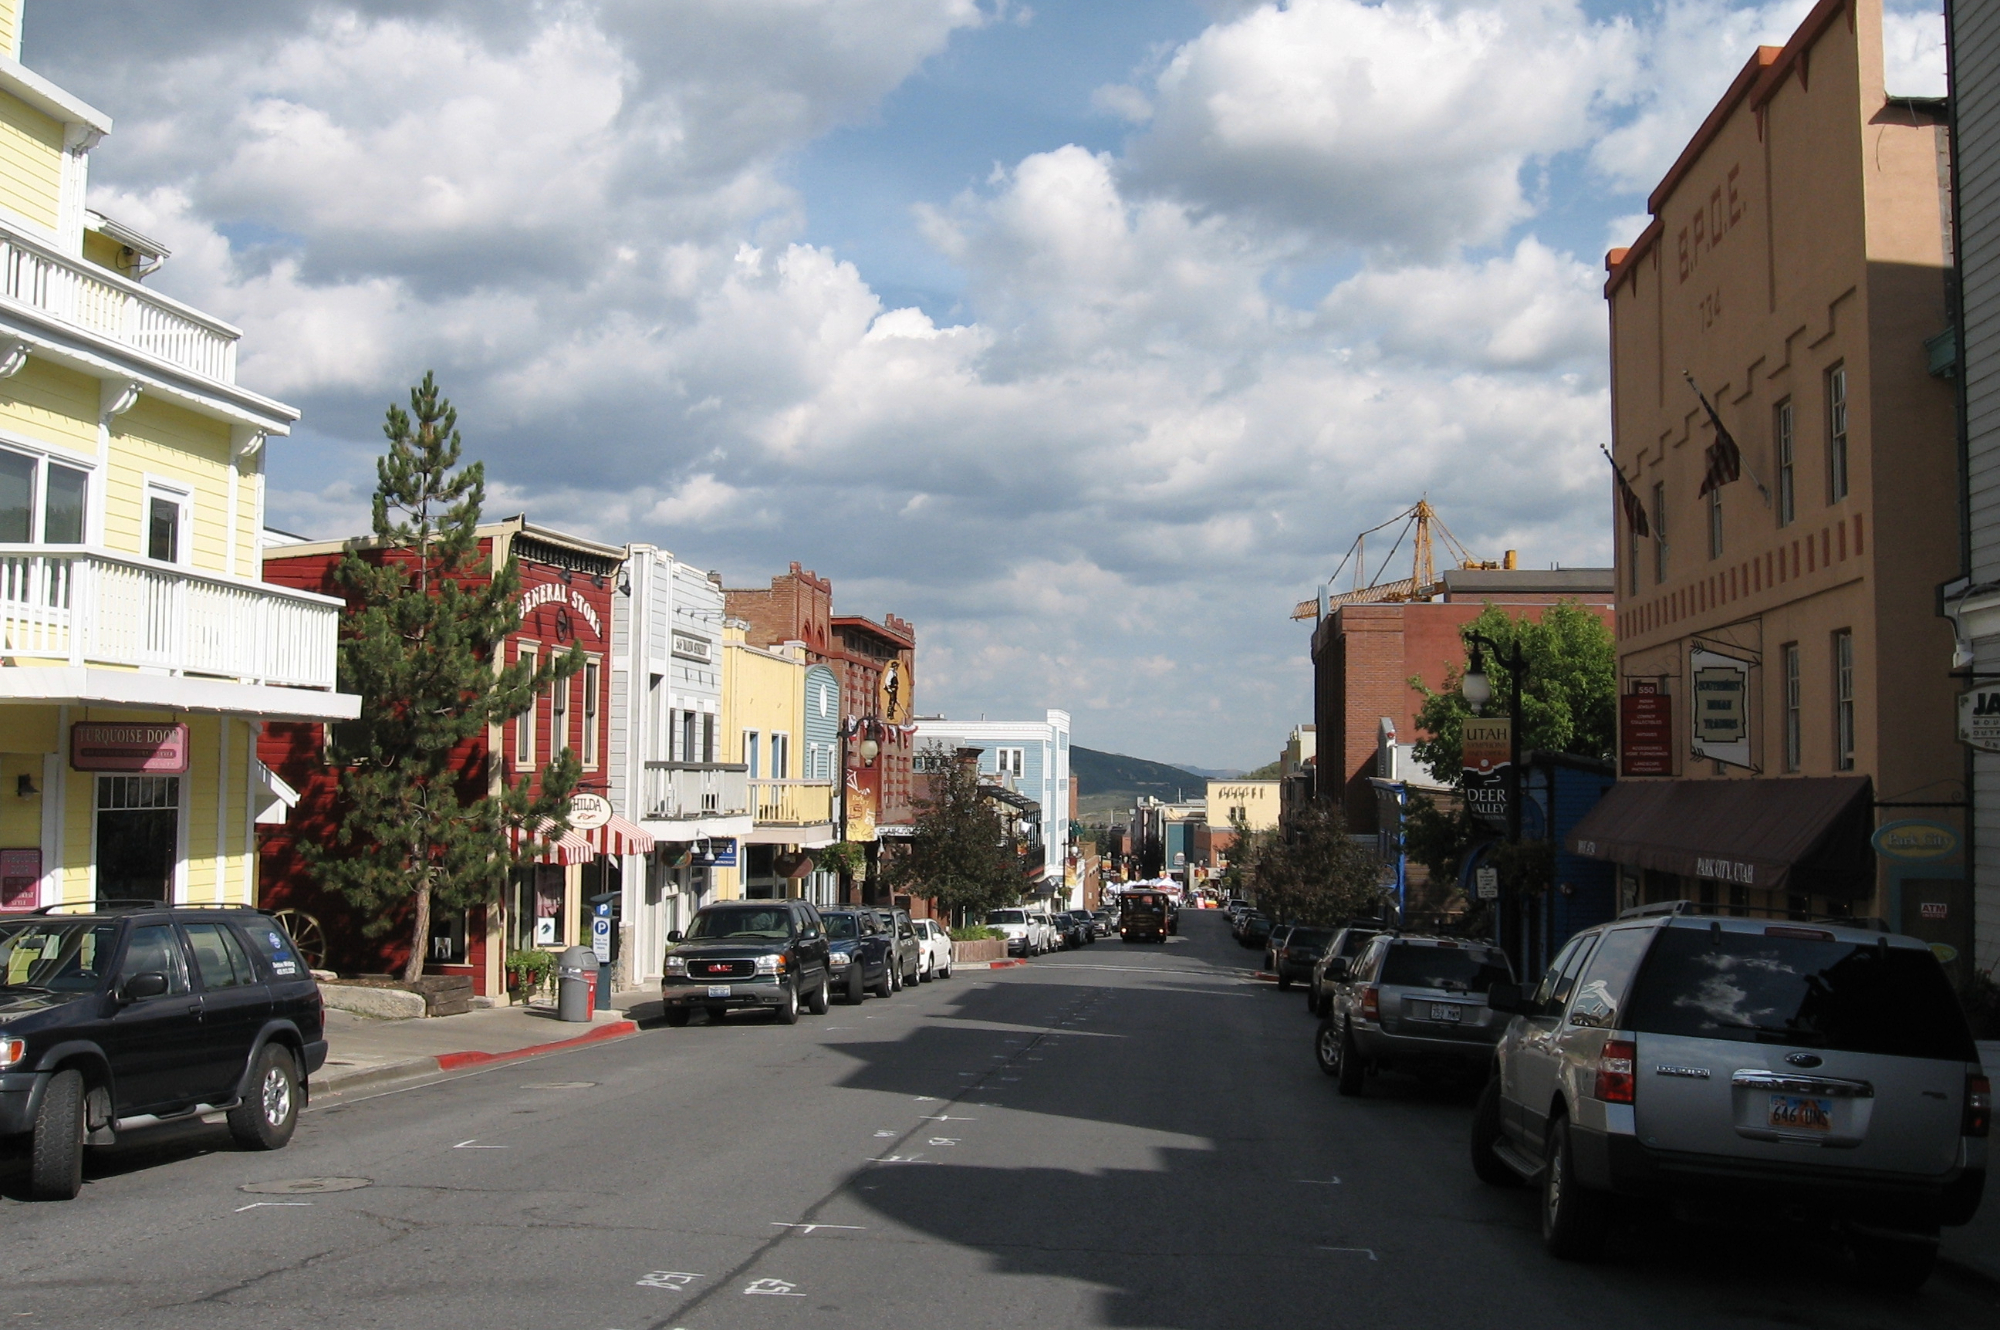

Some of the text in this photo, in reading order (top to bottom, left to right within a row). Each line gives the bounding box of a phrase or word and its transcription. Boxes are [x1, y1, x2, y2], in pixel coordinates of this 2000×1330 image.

[1638, 686, 1655, 694] 550
[79, 728, 142, 746] TURQUOISE
[1466, 728, 1507, 740] UTAH
[1467, 789, 1507, 802] DEER
[1469, 803, 1506, 813] VALLEY
[1888, 834, 1918, 846] Park
[1923, 834, 1951, 849] City
[1697, 858, 1714, 877] PARK
[1734, 862, 1753, 883] UTAH
[1923, 904, 1946, 913] ATM
[708, 964, 733, 972] GMC
[1773, 1106, 1797, 1122] 646
